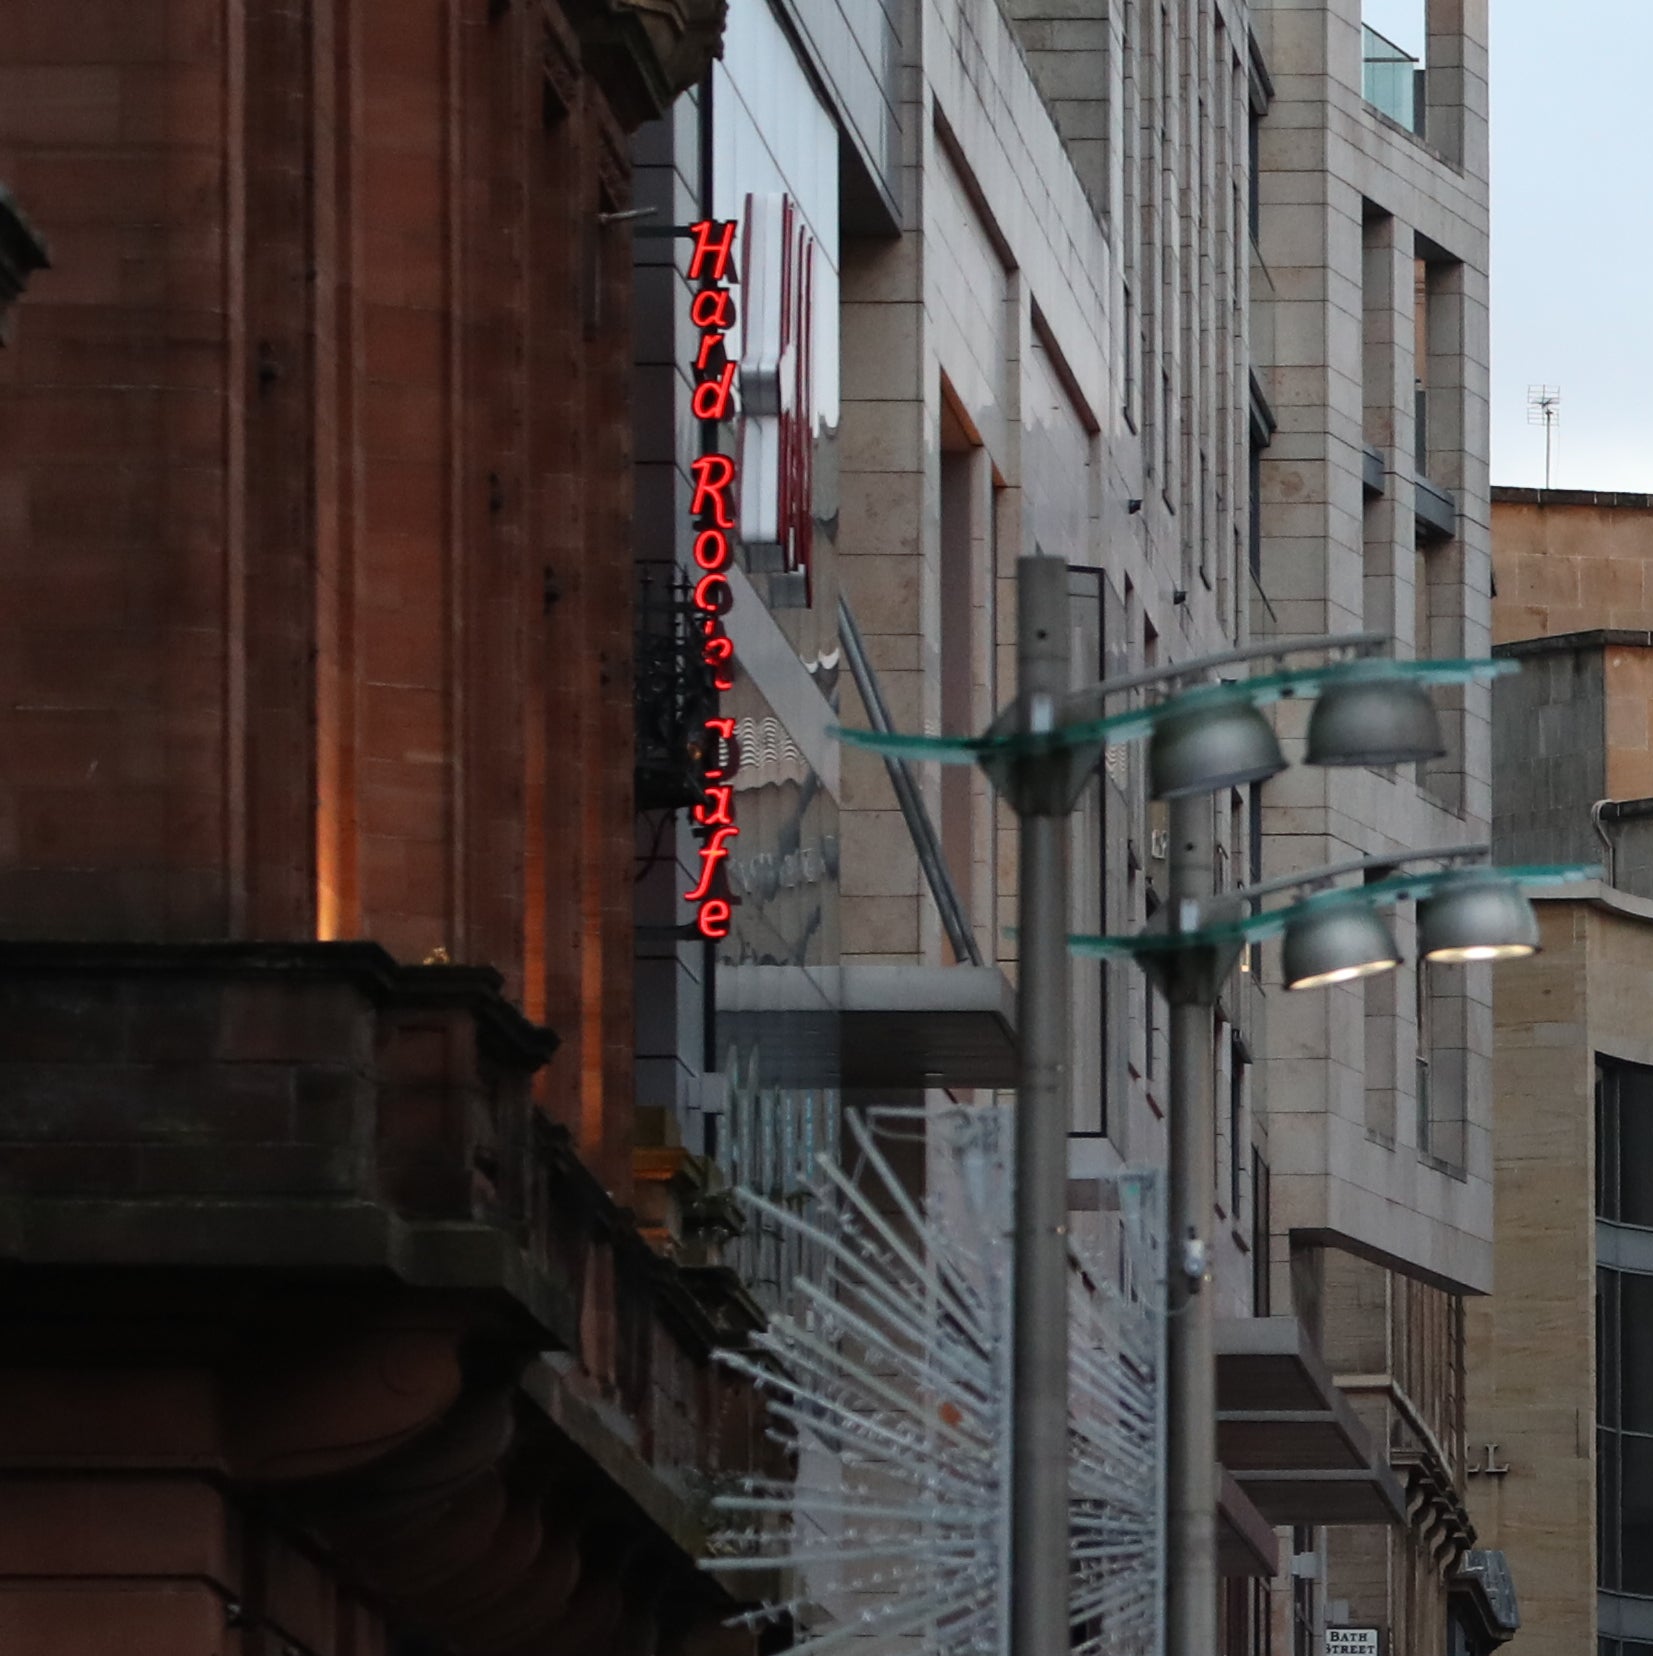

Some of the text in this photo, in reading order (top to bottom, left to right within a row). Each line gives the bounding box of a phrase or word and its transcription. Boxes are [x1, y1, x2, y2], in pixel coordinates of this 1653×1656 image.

[688, 220, 737, 421] Hard
[1330, 1631, 1367, 1642] BATH
[1326, 1644, 1375, 1654] STREET
